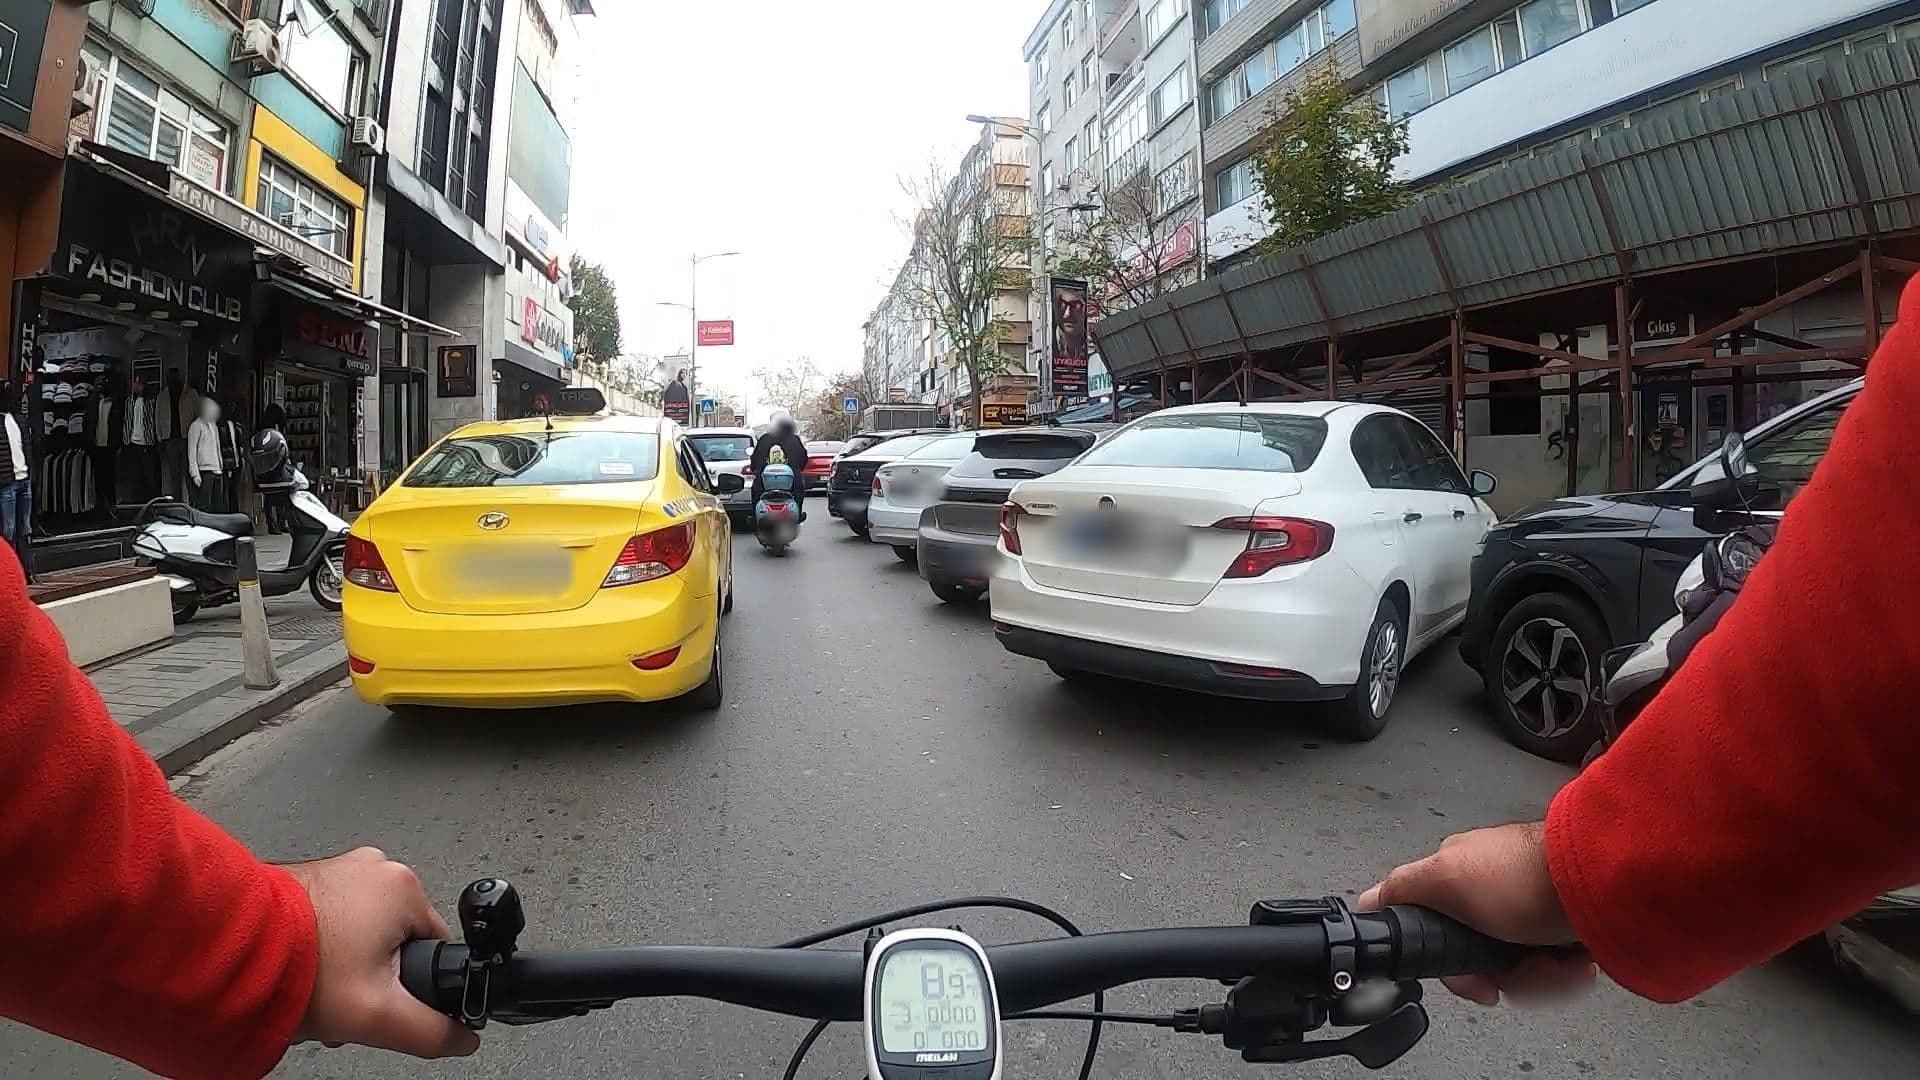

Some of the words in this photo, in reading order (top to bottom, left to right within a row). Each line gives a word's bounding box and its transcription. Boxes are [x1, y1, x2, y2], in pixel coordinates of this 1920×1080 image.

[68, 243, 184, 307] FASHION
[188, 284, 240, 323] CLUB
[21, 322, 35, 373] HRN
[1647, 319, 1677, 337] Çıkış
[207, 351, 218, 393] HRN
[916, 1053, 958, 1064] MEILAN
